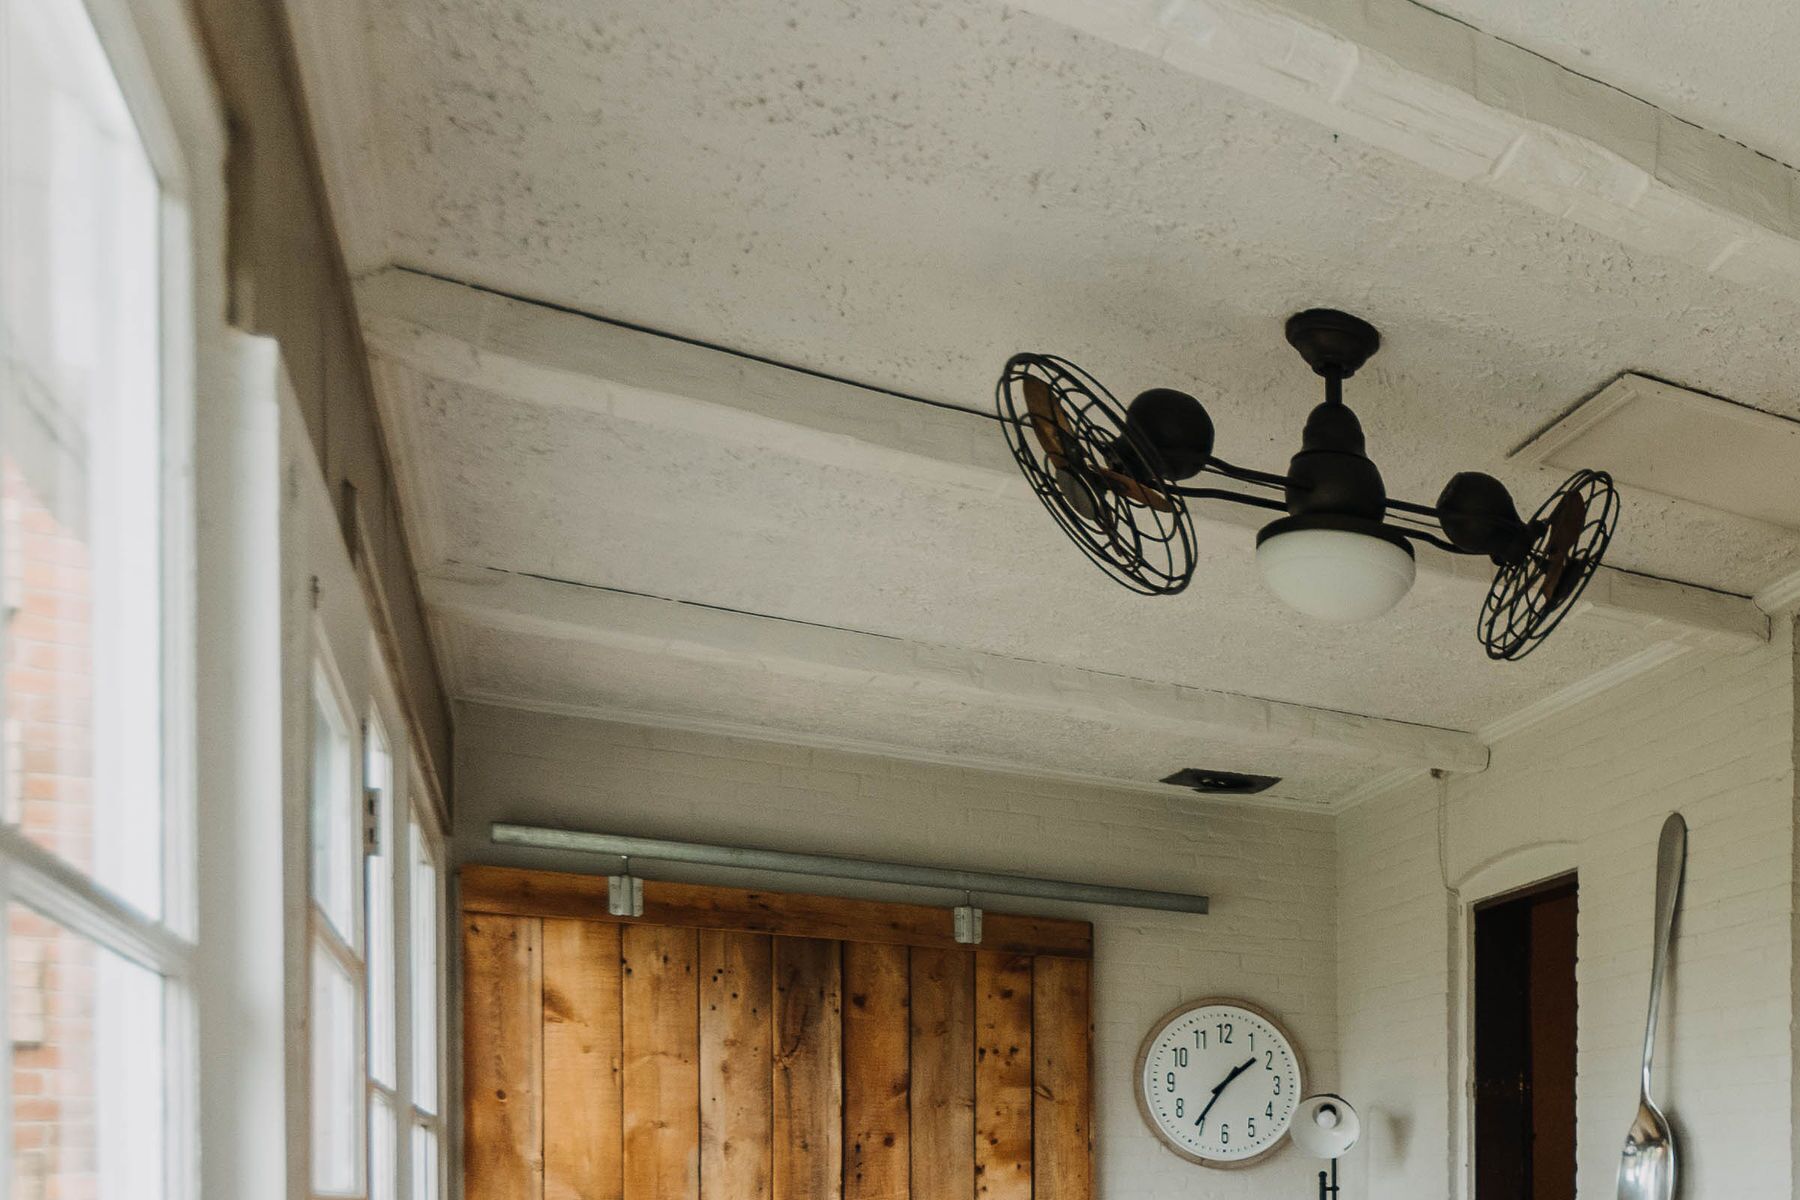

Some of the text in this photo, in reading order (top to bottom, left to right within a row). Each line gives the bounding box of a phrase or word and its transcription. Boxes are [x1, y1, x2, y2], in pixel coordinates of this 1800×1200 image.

[1193, 1029, 1208, 1050] 11
[1215, 1023, 1233, 1044] 12
[1248, 1032, 1254, 1051] 1
[1171, 1046, 1188, 1067] 10
[1265, 1050, 1273, 1071] 2
[1166, 1072, 1176, 1092] 9
[1272, 1075, 1281, 1095] 3
[1175, 1098, 1184, 1118] 8
[1265, 1101, 1273, 1120] 4
[1221, 1123, 1229, 1144] 6
[1247, 1117, 1255, 1138] 5
